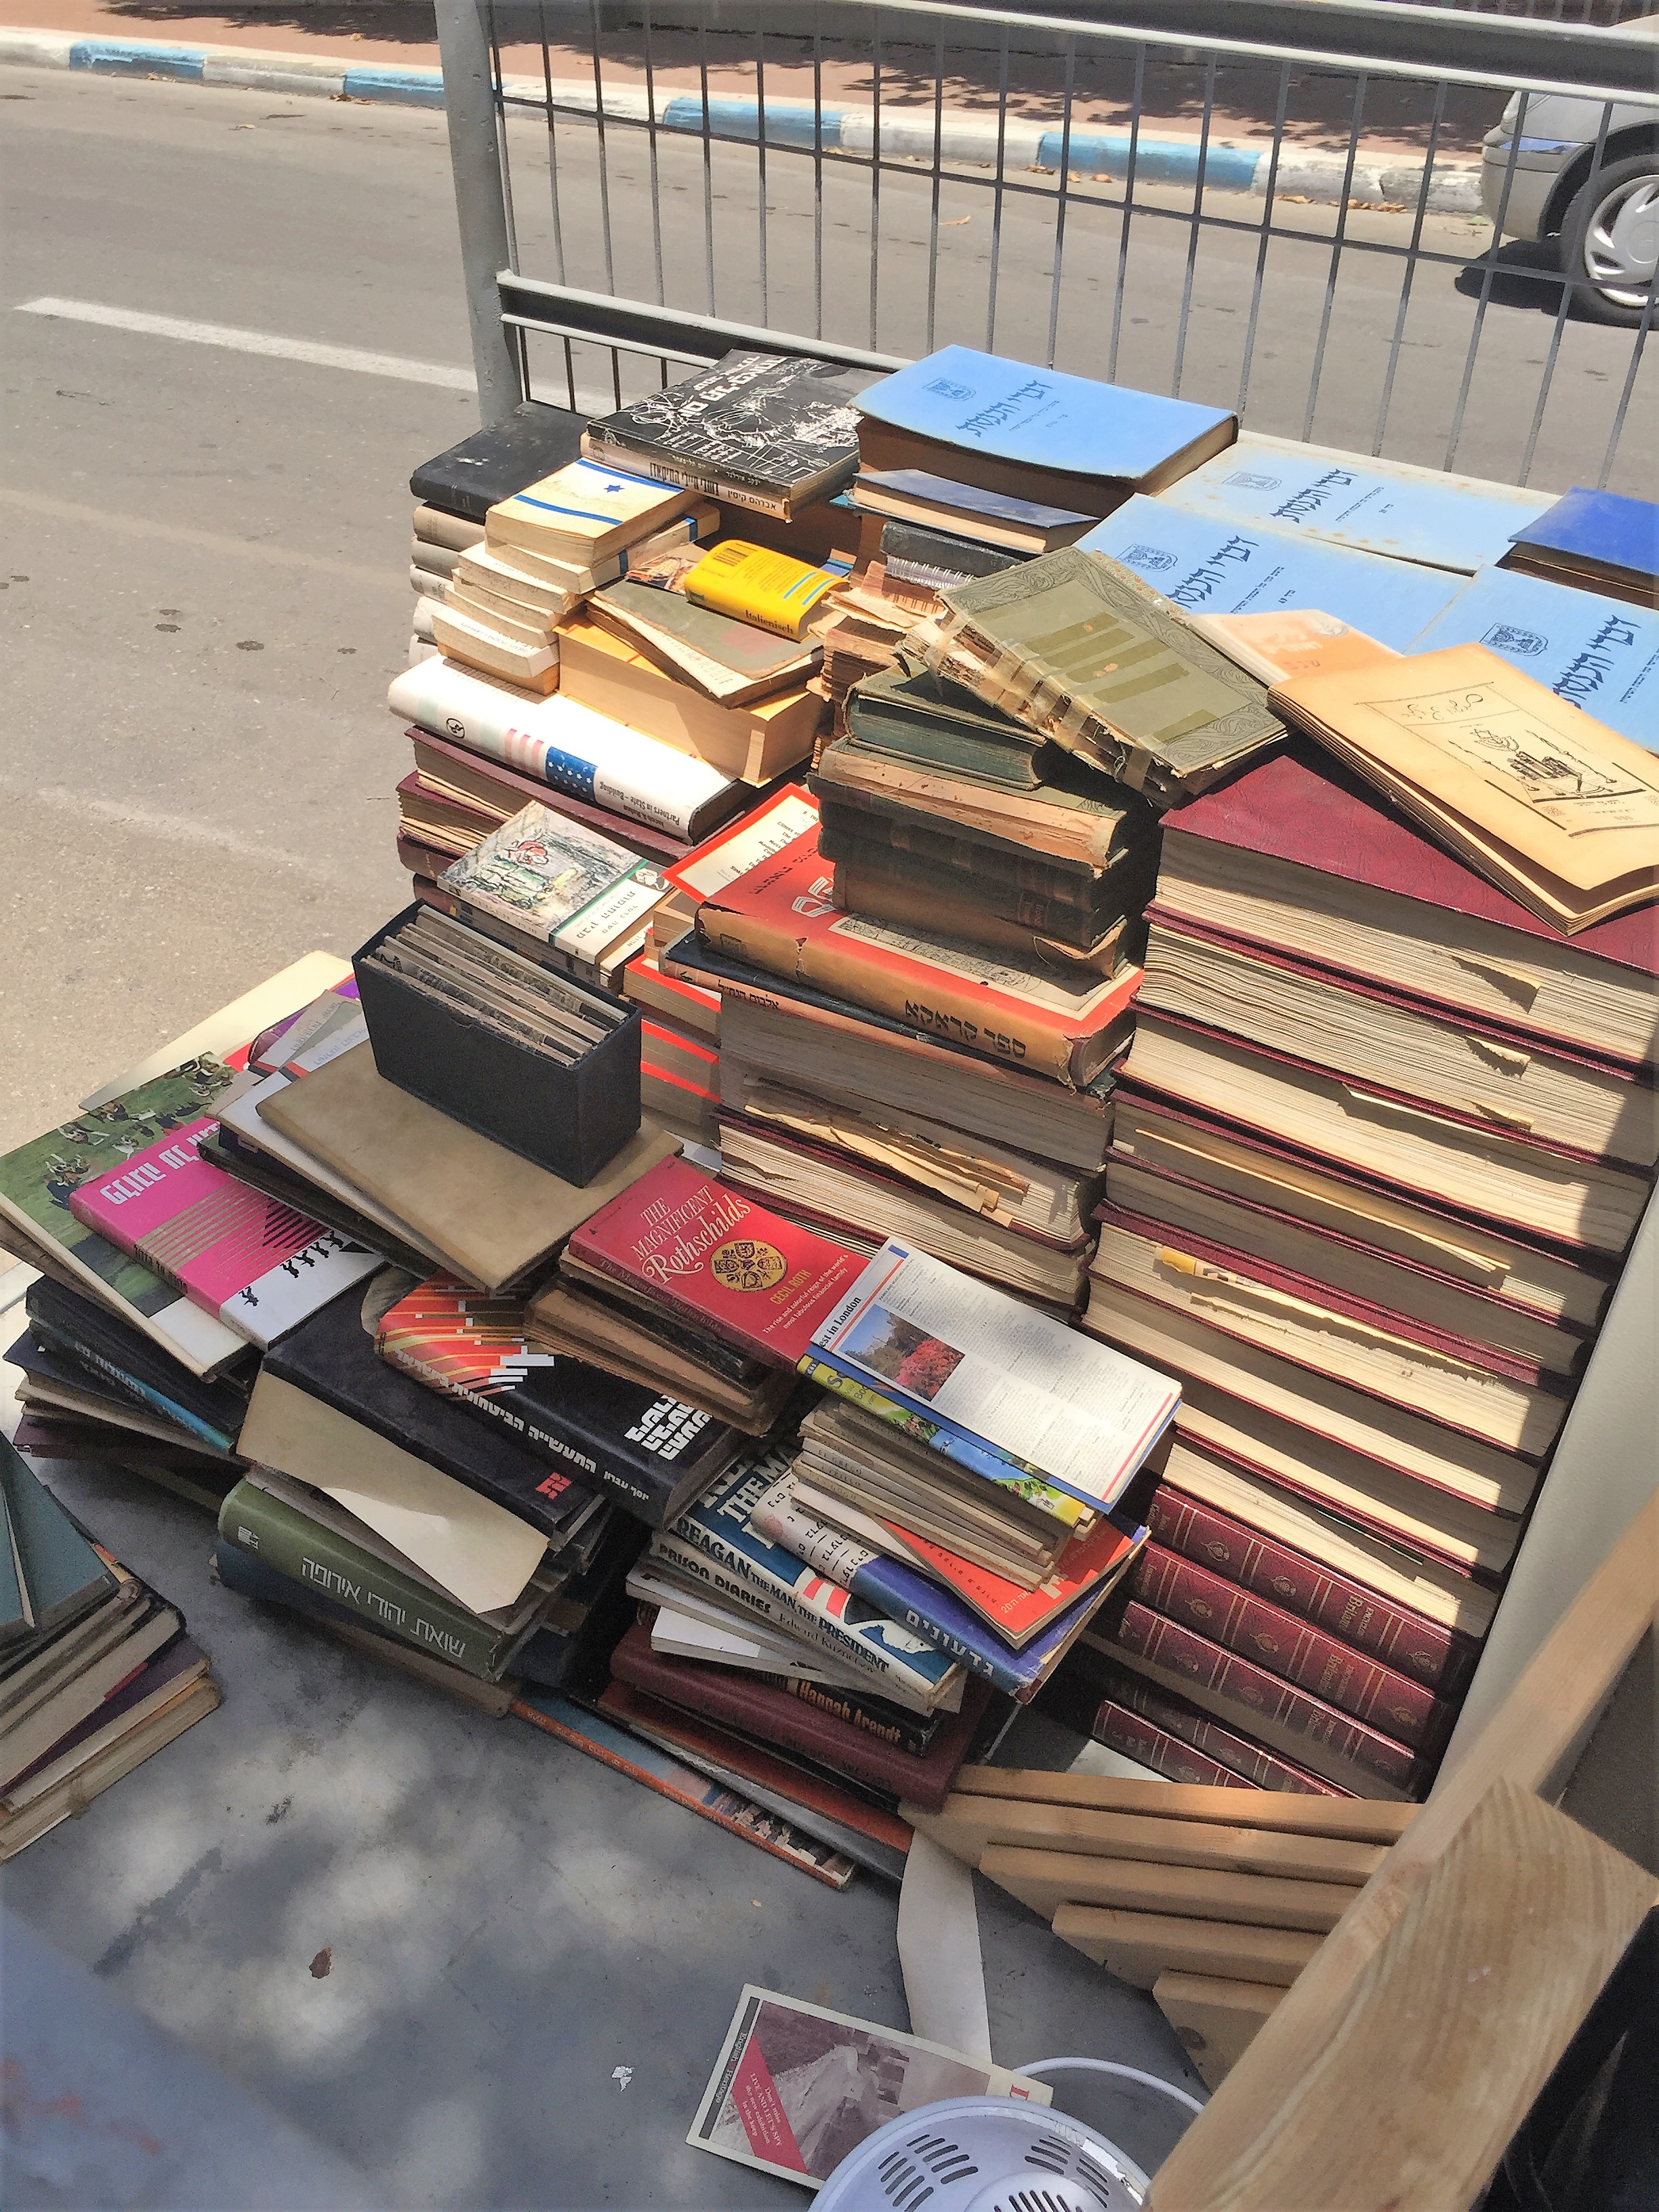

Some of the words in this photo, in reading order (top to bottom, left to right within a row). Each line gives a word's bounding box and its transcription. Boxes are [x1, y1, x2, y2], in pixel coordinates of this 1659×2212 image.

[1006, 380, 1054, 403] דברי
[956, 397, 1012, 437] הכנסת
[1311, 469, 1359, 487] דברי
[727, 489, 747, 503] קיסין
[749, 496, 777, 511] אברהם
[1269, 489, 1332, 524] הכנסת
[1206, 535, 1259, 567] דברי
[745, 609, 794, 636] Italienisch
[1586, 614, 1642, 652] דברי
[599, 781, 625, 800] Building
[630, 796, 647, 811] State
[653, 806, 680, 826] Partners
[576, 921, 598, 939] מבין
[602, 890, 636, 919] החומות
[905, 1000, 979, 1042] קראקא
[984, 1027, 1026, 1059] ספר
[100, 1164, 166, 1206] פלוגה
[161, 1145, 200, 1171] על
[630, 1185, 716, 1262] MAGNIFICENT
[640, 1196, 671, 1227] THE
[641, 1193, 752, 1285] Rothschilds
[762, 1322, 775, 1334] The
[773, 1315, 783, 1327] rise
[782, 1306, 793, 1319] and
[790, 1292, 809, 1313] colorful
[806, 1279, 820, 1297] reign
[831, 1253, 850, 1273] world's
[769, 1284, 794, 1305] CECIL
[792, 1269, 813, 1290] ROTH
[783, 1316, 796, 1330] most
[794, 1300, 815, 1322] fabulous
[812, 1282, 834, 1305] financial
[832, 1267, 849, 1286] family
[827, 1324, 838, 1336] in
[838, 1295, 863, 1327] London
[452, 1380, 527, 1432] הביטחונית
[528, 1423, 597, 1475] התעשייה
[602, 1471, 629, 1492] עברון
[628, 1483, 651, 1502] יוסף
[656, 1408, 713, 1464] התעש
[716, 1476, 766, 1523] THE
[300, 1555, 363, 1606] אירופה
[659, 1542, 711, 1582] PRISON
[714, 1574, 771, 1614] DIARIES
[366, 1589, 408, 1626] יהודי
[678, 1518, 752, 1580] REAGAN
[750, 1570, 771, 1593] THE
[769, 1583, 798, 1613] MAN,
[797, 1602, 819, 1626] THE
[818, 1614, 890, 1674] PRESIDENT
[409, 1617, 466, 1660] שואת
[905, 1609, 995, 1678] גדעונים
[798, 1681, 851, 1719] Hannah
[853, 1706, 902, 1744] Arendt
[730, 2031, 747, 2063] English
[750, 2072, 762, 2093] LIVE
[764, 2086, 775, 2106] Don't
[750, 2094, 759, 2110] new
[758, 2092, 769, 2110] AND
[749, 2119, 758, 2137] keep
[754, 2110, 771, 2145] exhibition
[763, 2109, 776, 2132] LET'S
[772, 2129, 783, 2148] SPY
